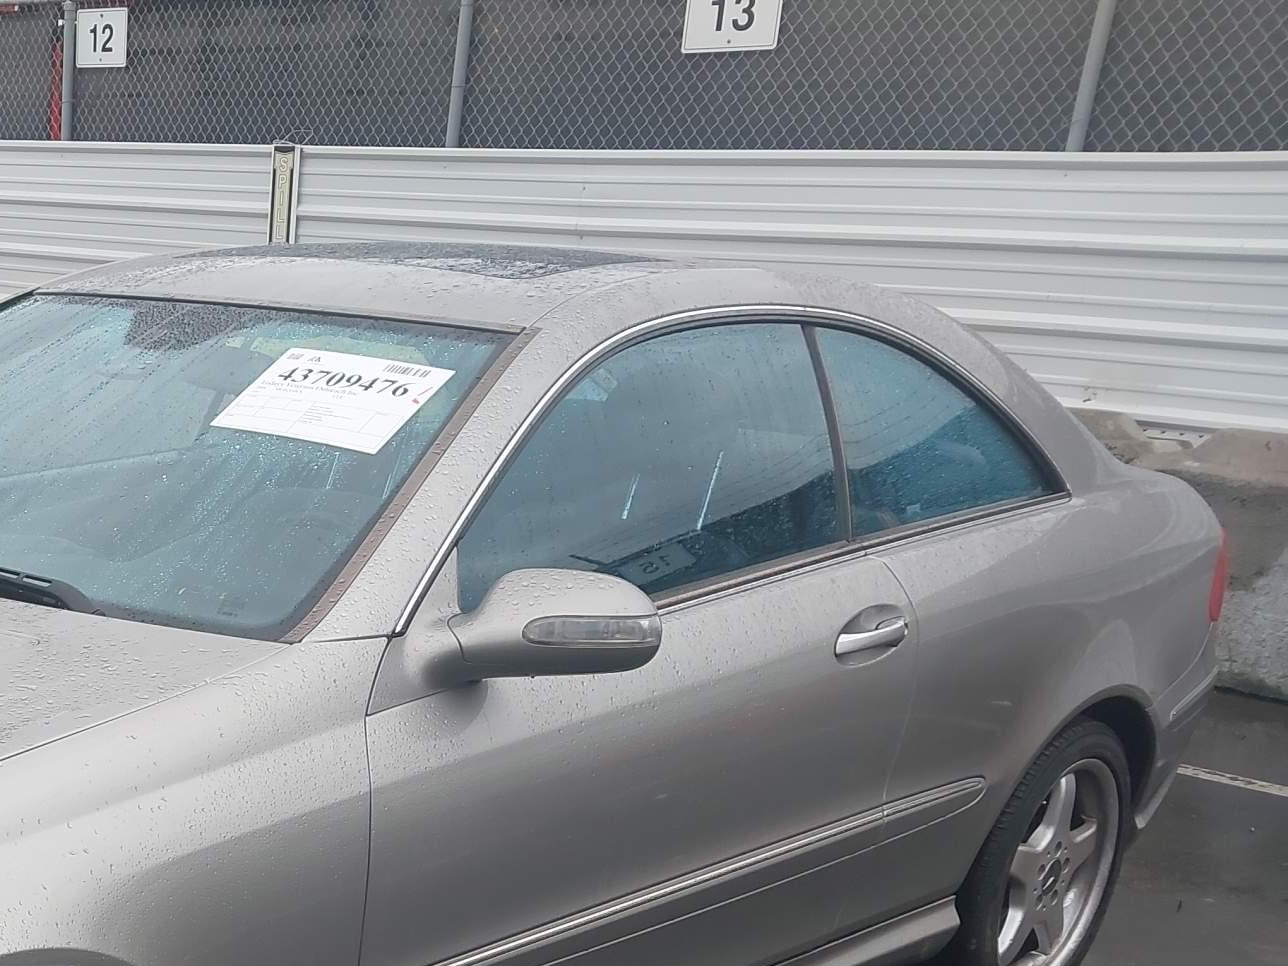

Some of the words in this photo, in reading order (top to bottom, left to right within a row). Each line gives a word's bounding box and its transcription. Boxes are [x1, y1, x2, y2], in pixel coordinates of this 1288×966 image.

[711, 0, 756, 32] 13
[89, 23, 114, 53] 12
[276, 157, 289, 240] SPILL
[278, 367, 416, 398] 43709476
